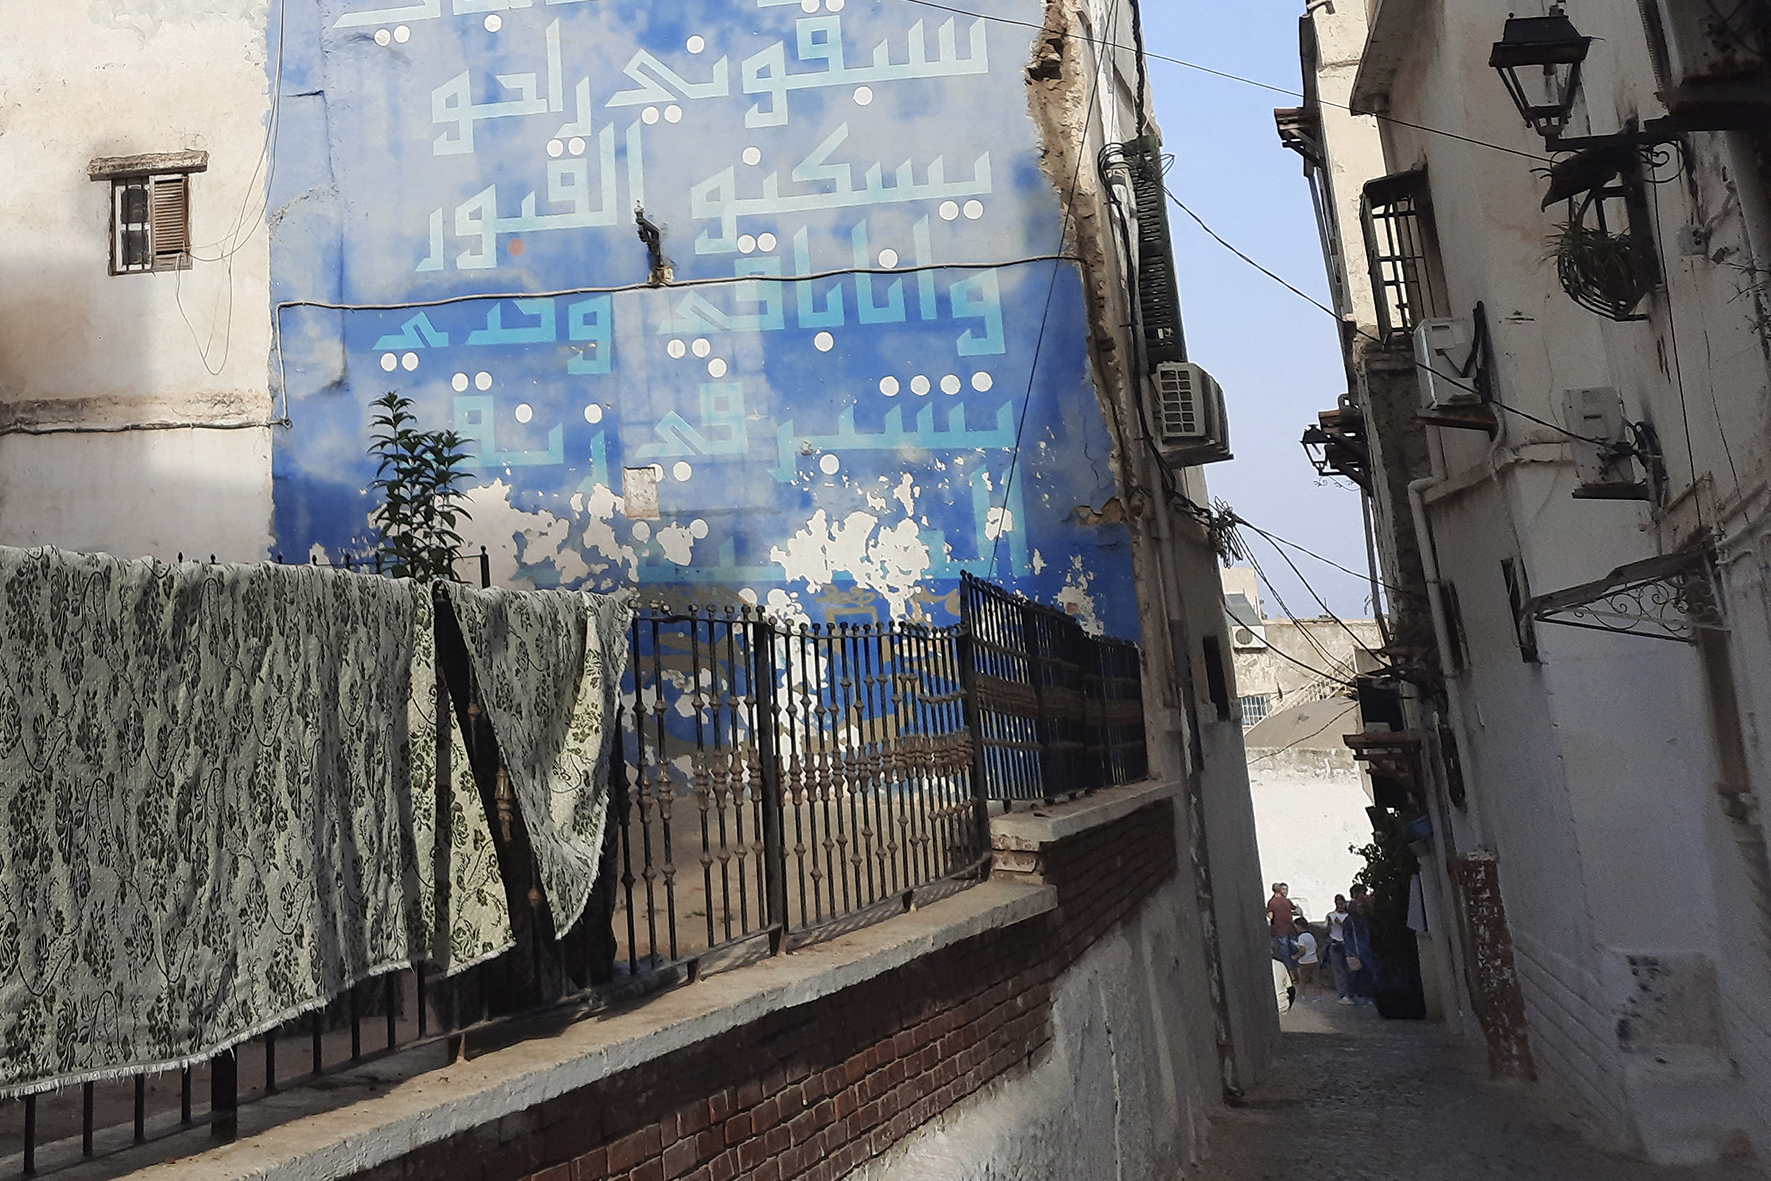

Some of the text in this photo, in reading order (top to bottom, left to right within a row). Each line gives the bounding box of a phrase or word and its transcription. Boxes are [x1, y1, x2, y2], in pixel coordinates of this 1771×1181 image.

[430, 19, 593, 156] راحو
[417, 120, 993, 272] يسكنو القبور
[373, 291, 613, 374] وحدي
[635, 357, 746, 481] في
